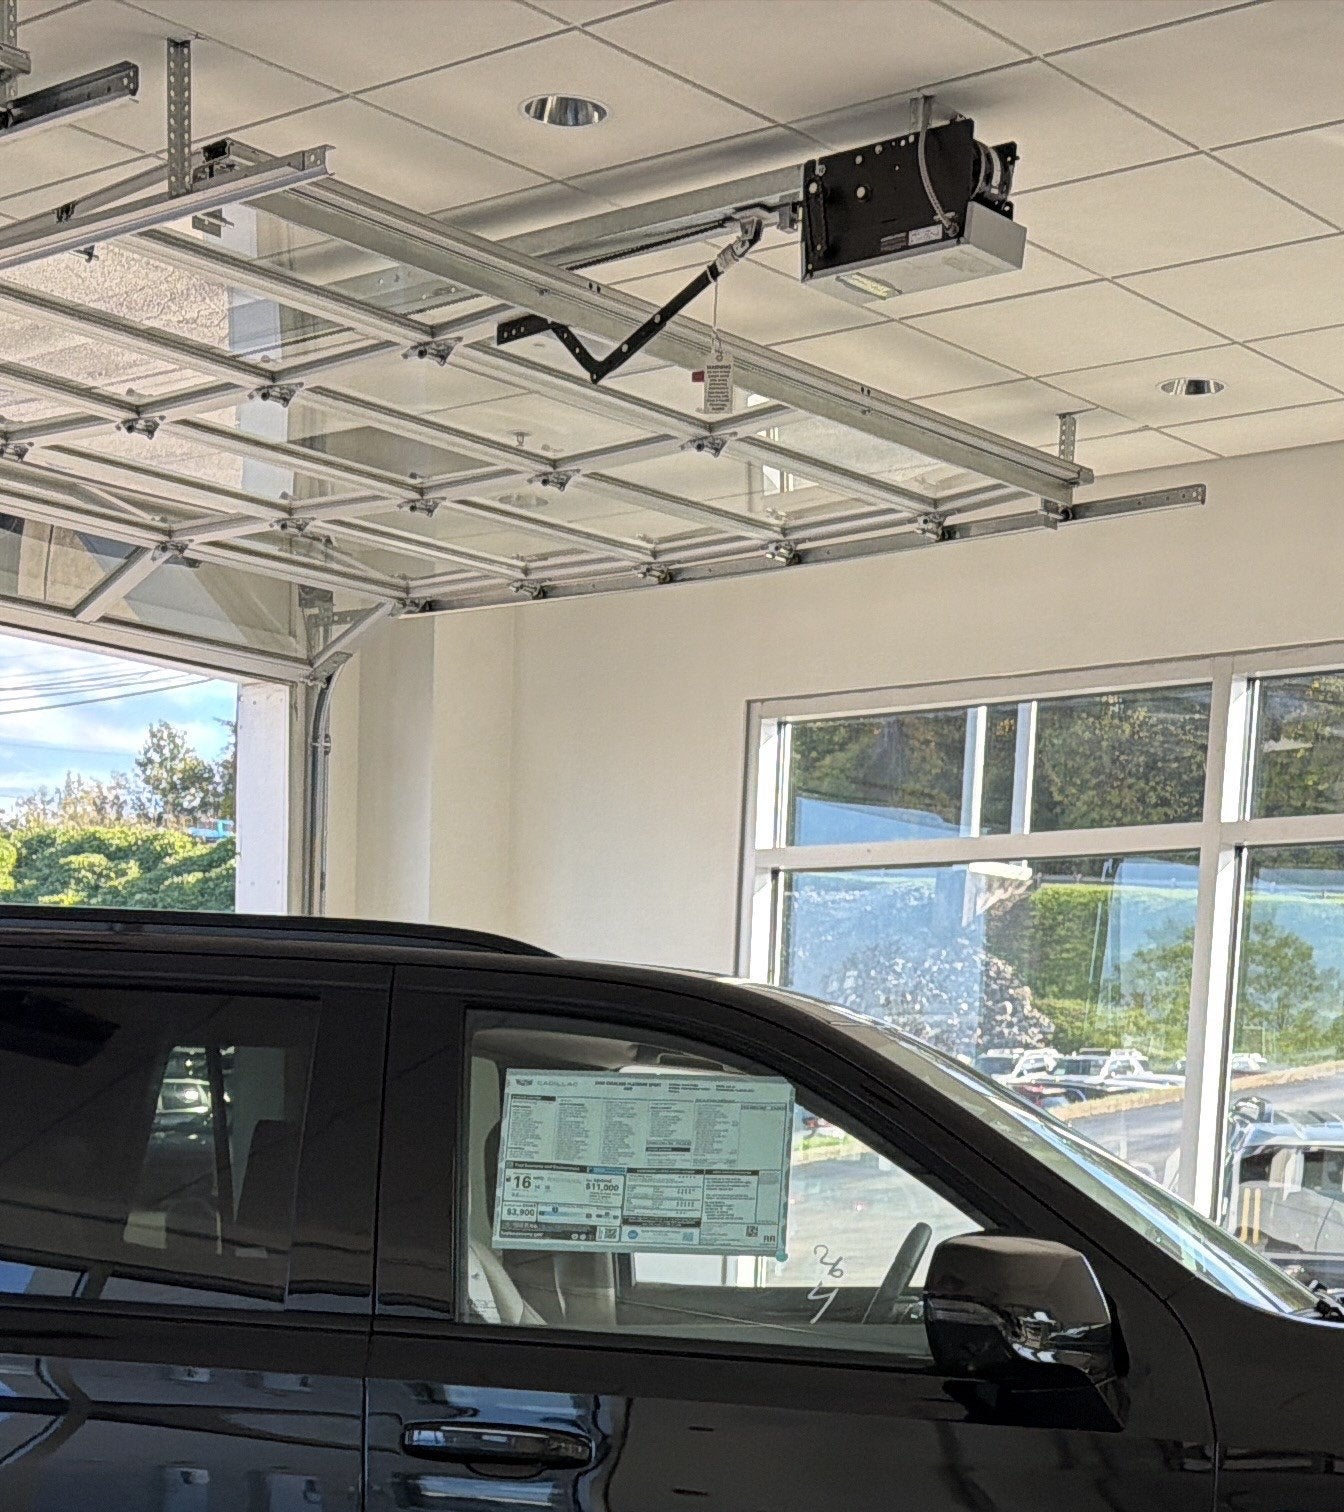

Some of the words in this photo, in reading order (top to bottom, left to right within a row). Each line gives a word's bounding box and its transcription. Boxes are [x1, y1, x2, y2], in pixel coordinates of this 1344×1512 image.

[513, 1175, 532, 1189] 16
[585, 1182, 620, 1192] $11,000
[813, 1244, 844, 1279] 26
